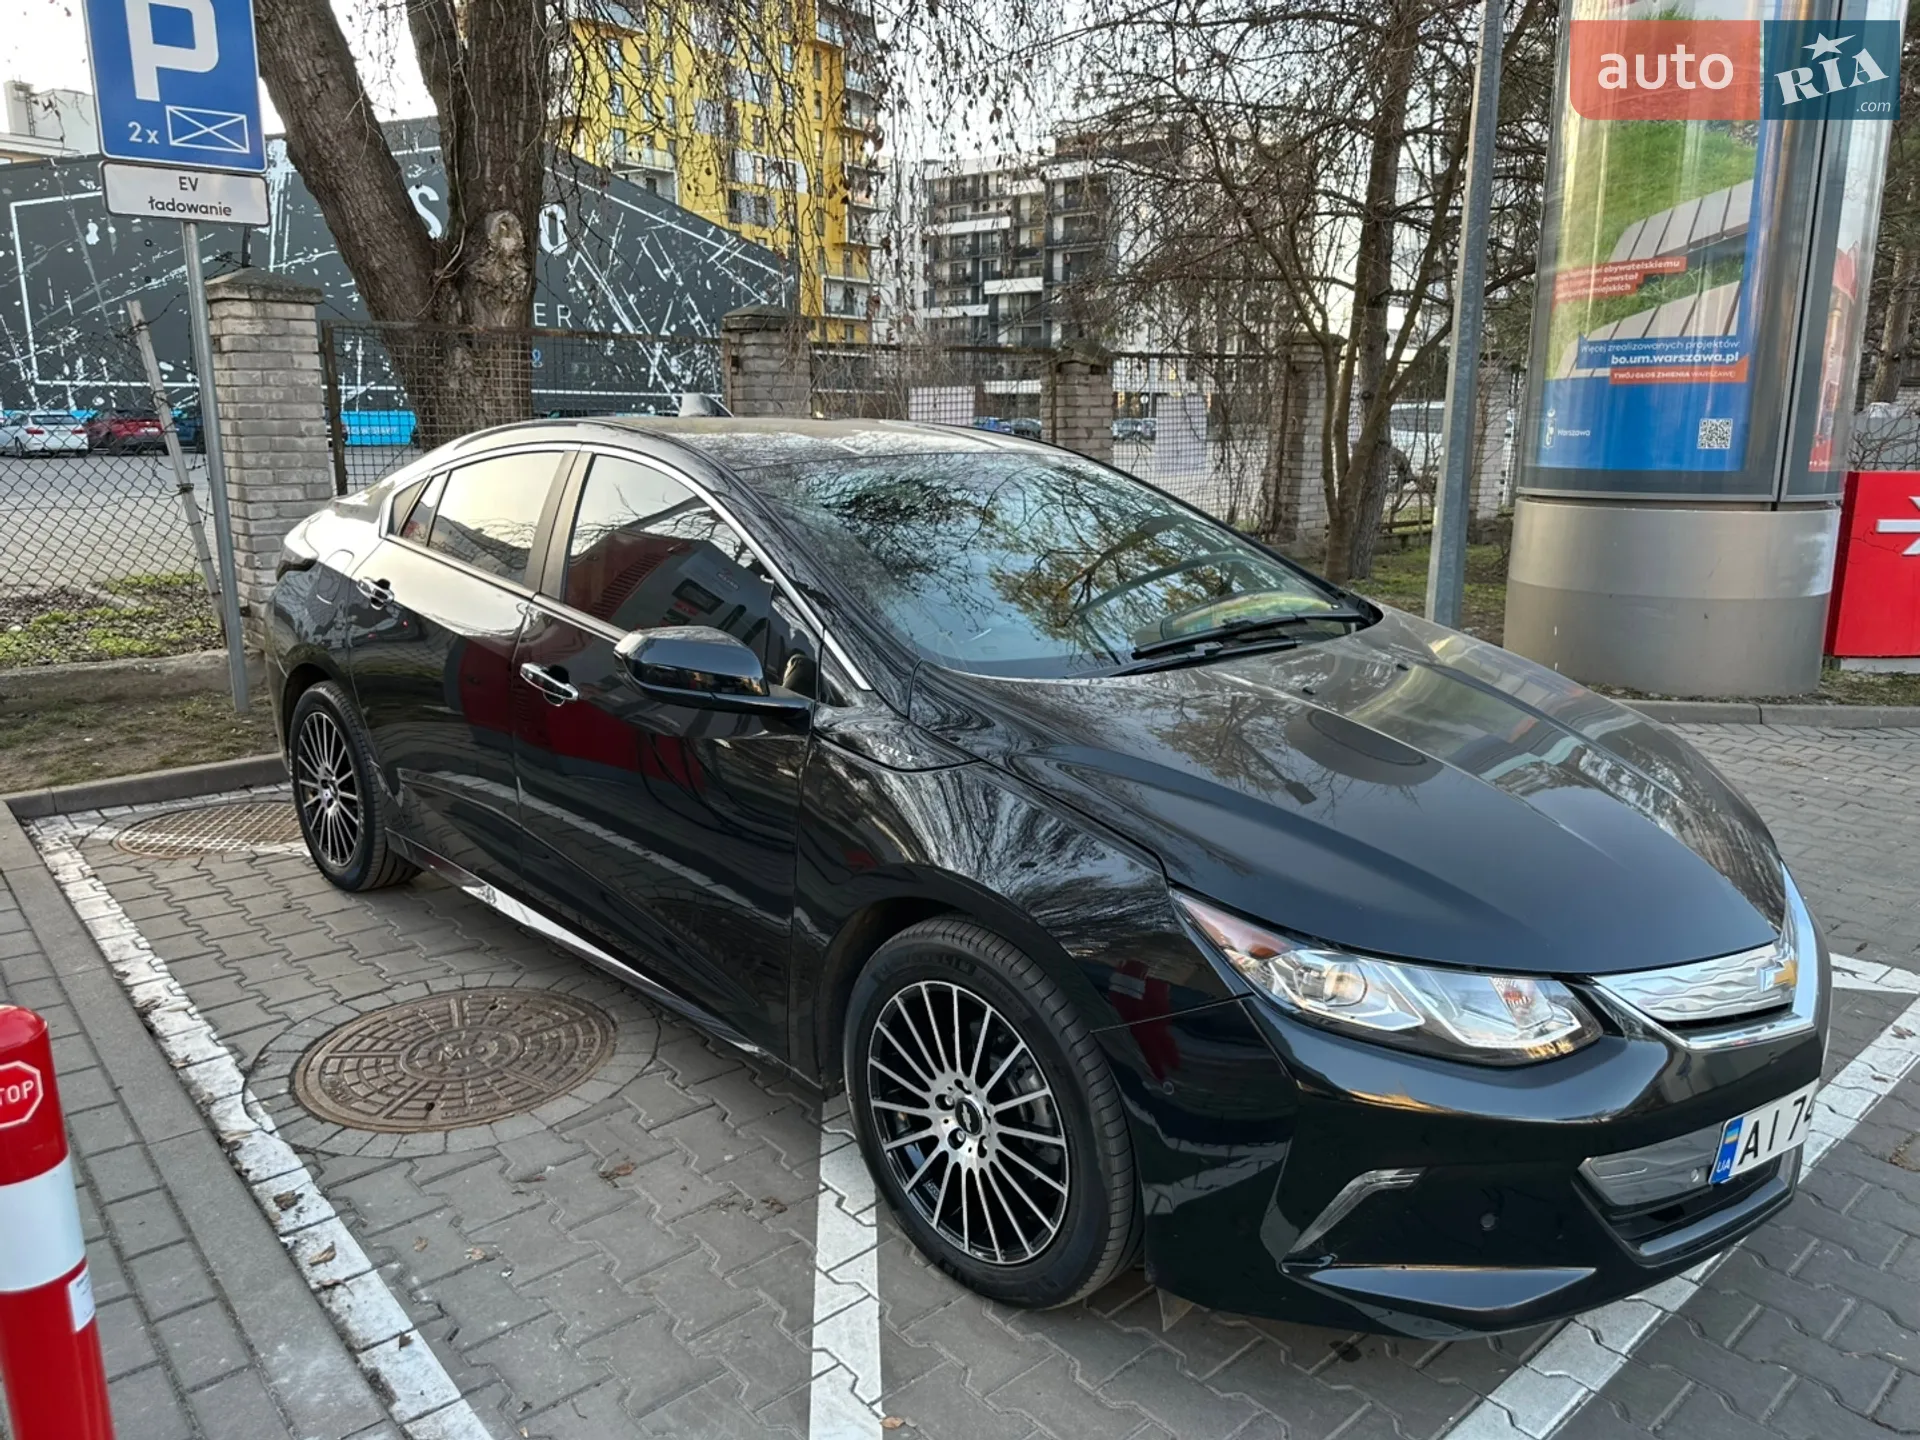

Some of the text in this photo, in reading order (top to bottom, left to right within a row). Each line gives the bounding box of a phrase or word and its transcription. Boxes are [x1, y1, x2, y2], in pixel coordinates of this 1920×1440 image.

[124, 0, 220, 102] P
[178, 176, 199, 192] EV
[148, 196, 232, 217] ładowanie
[1603, 260, 1680, 273] obywatelskiemu
[1602, 272, 1638, 284] powstał
[1607, 340, 1684, 352] zrealizowanych
[1611, 351, 1740, 365] bo.um.warszawa.pl
[1614, 371, 1634, 379] TWÓJ
[1656, 370, 1690, 379] ZMIENIA
[1716, 1157, 1731, 1173] UA
